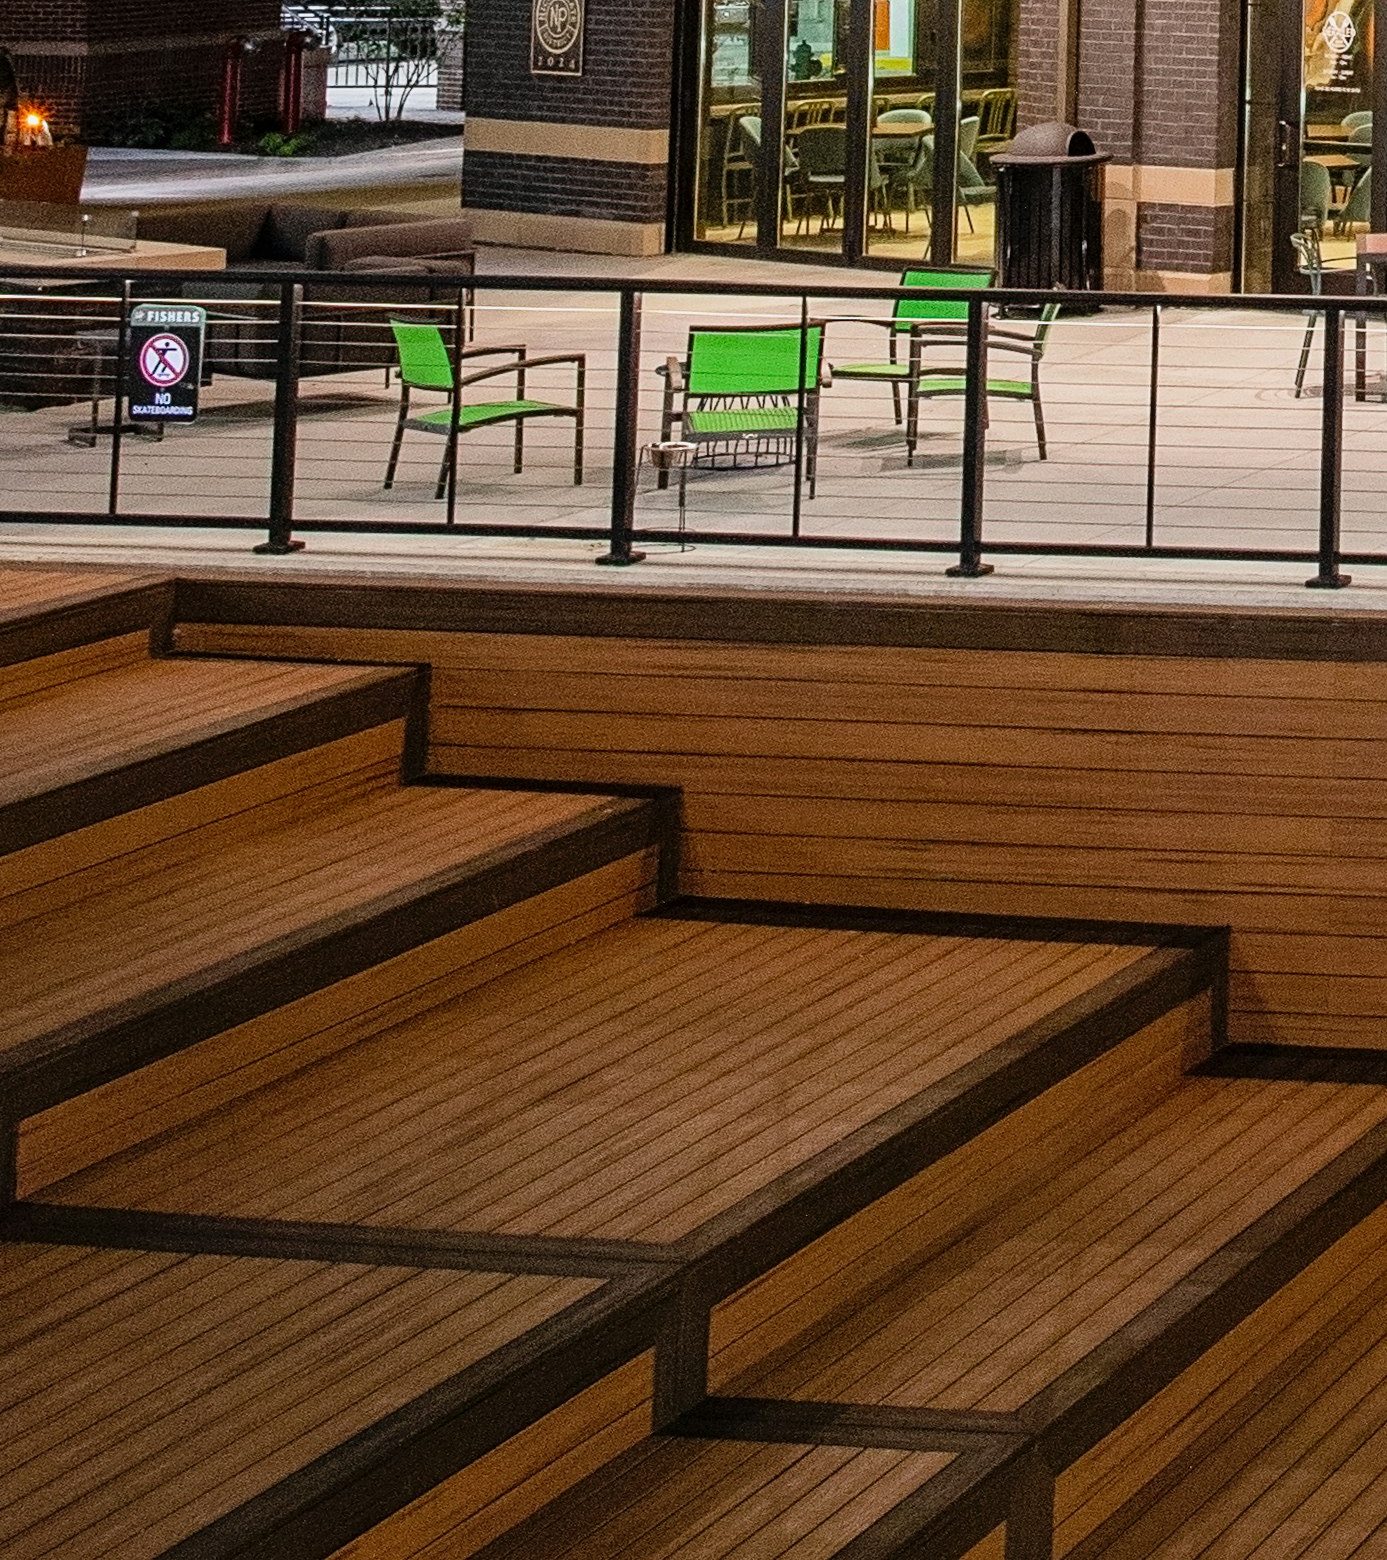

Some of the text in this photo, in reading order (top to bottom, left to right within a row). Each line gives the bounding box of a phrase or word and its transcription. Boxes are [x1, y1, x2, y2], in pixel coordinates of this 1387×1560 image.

[147, 311, 200, 323] FISHERS
[154, 392, 171, 405] NO
[132, 405, 193, 416] SKATEBOARDING
